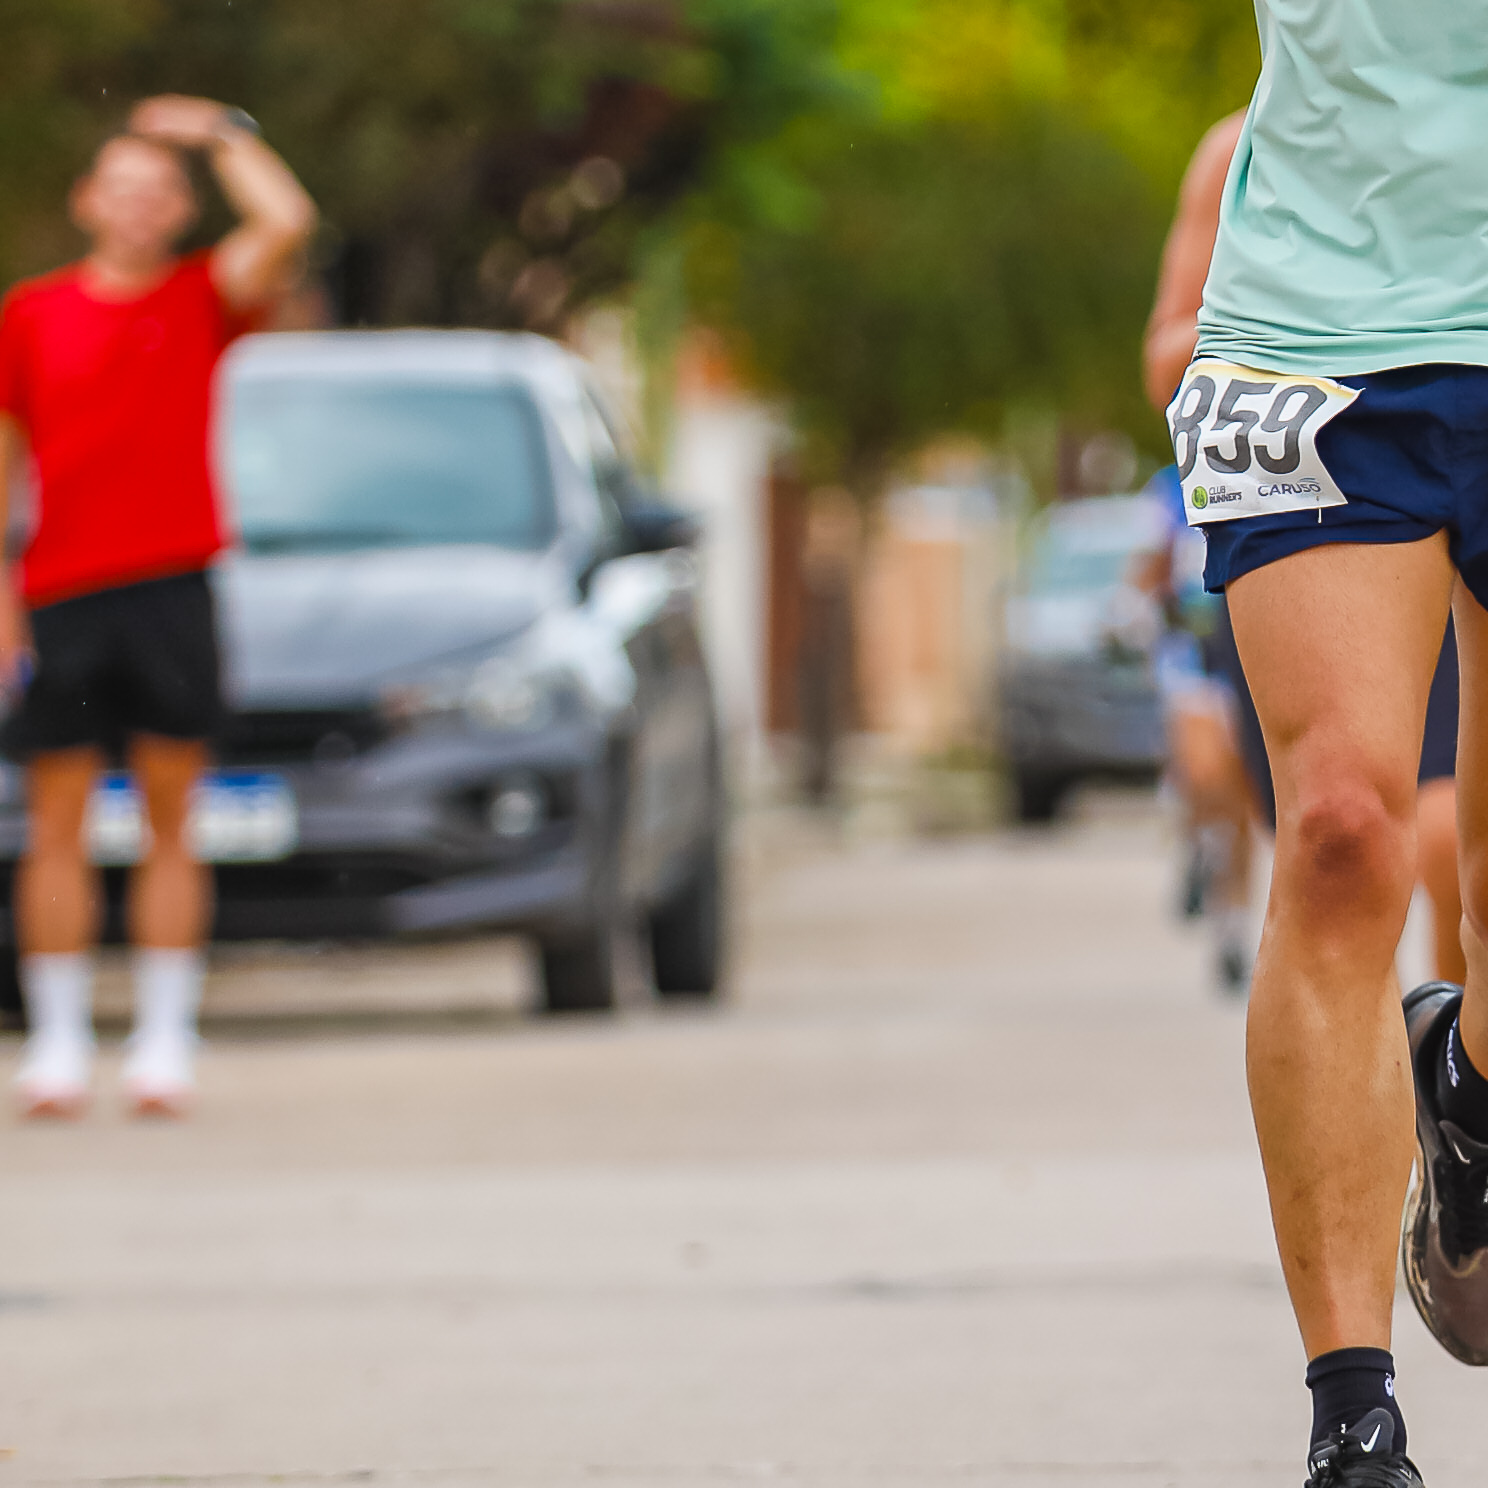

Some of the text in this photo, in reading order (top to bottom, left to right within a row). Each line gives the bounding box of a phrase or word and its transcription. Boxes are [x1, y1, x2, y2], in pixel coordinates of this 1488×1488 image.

[1173, 375, 1327, 481] 859
[1208, 485, 1226, 496] CLUB
[1257, 483, 1322, 497] CARUSO
